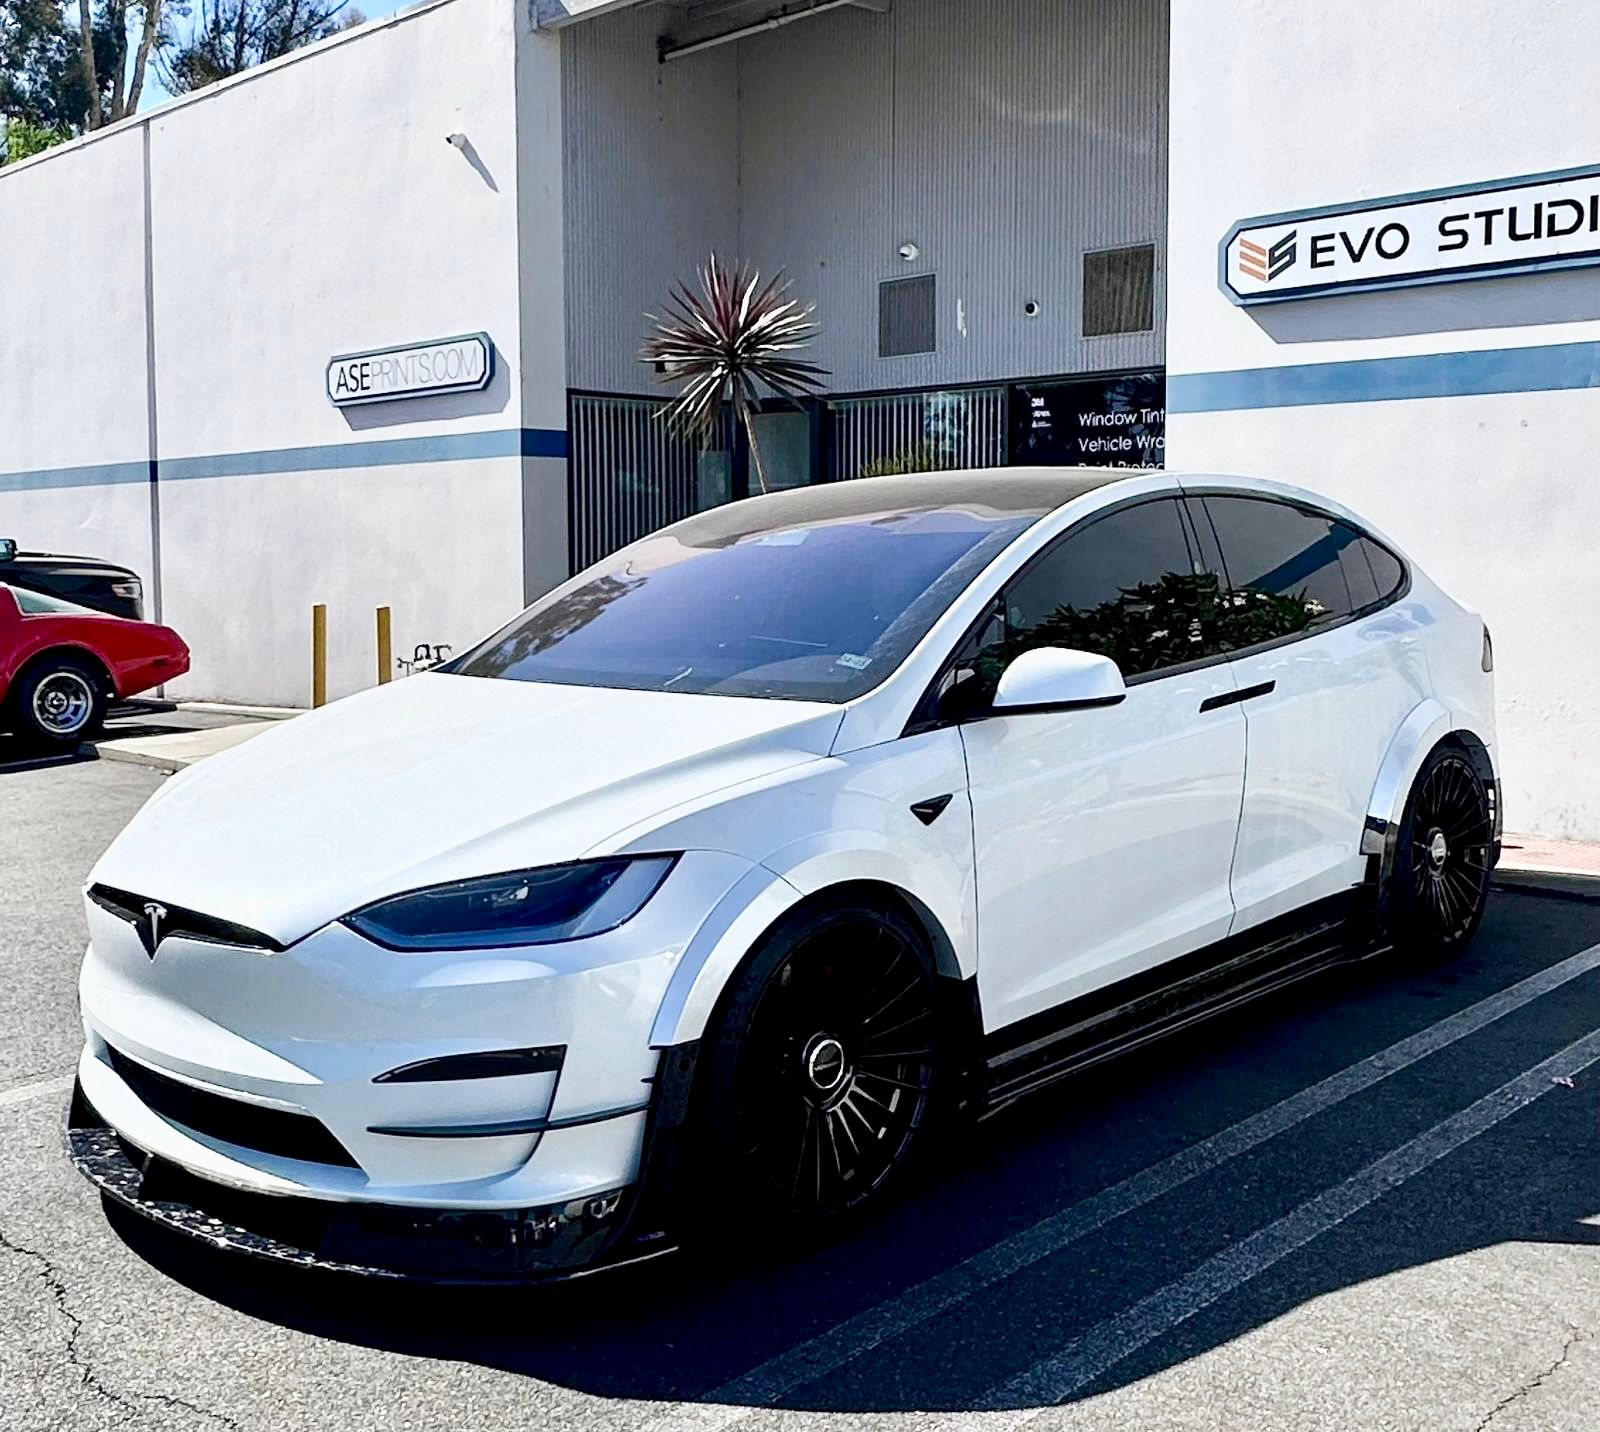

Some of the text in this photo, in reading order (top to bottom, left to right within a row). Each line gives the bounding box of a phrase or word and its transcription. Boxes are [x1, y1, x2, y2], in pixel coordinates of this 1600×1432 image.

[1310, 222, 1410, 270] EVO
[1437, 194, 1599, 252] STUDI
[335, 345, 479, 395] ASEPRINTS.COM
[1078, 407, 1165, 427] Window Tint
[1078, 435, 1132, 452] Vehicle
